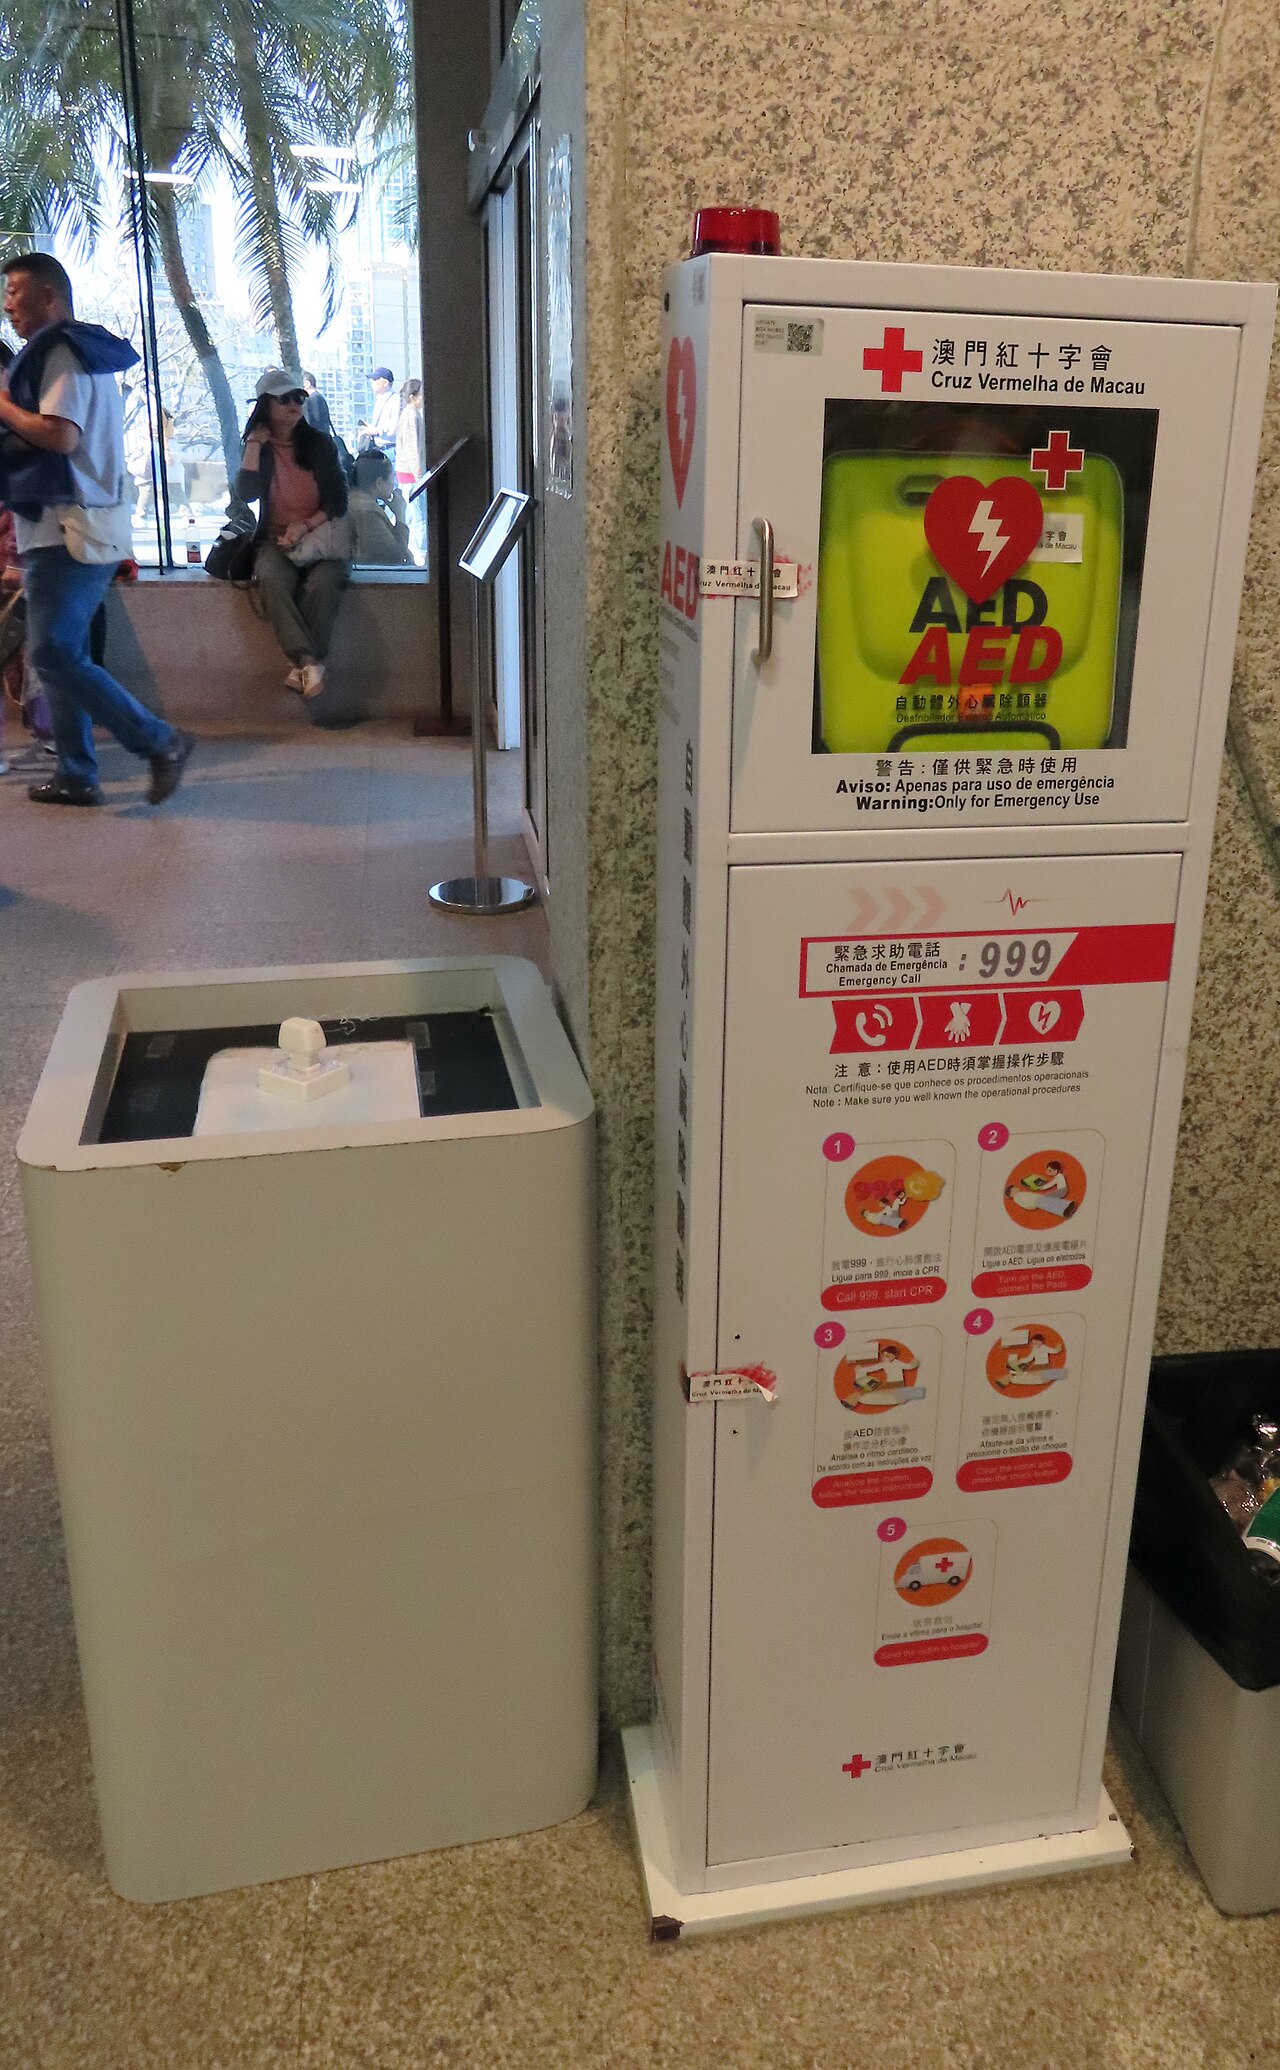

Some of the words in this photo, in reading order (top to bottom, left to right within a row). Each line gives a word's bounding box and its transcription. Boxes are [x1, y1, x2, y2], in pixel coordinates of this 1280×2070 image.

[931, 338, 1112, 371] 澳門紅十字會
[931, 370, 972, 388] Cruz
[978, 372, 1058, 392] Vermelha
[1063, 376, 1084, 392] de
[1090, 376, 1145, 395] Macau
[660, 540, 700, 620] AED
[707, 564, 782, 579] 澳門紅十會
[909, 576, 1048, 635] AED
[898, 625, 1063, 685] AED
[835, 779, 891, 794] Aviso:
[895, 778, 947, 794] Apenas
[952, 779, 982, 794] para
[986, 779, 1012, 790] uso
[1015, 777, 1032, 790] de
[1036, 775, 1115, 793] emergência
[971, 795, 990, 808] for
[994, 793, 1070, 810] Emergency
[1074, 792, 1100, 806] Use
[834, 942, 941, 962] 緊急求助電話
[978, 939, 1052, 979] 999
[826, 962, 873, 974] Chamada
[875, 961, 888, 972] de
[890, 959, 948, 973] Emergência
[838, 975, 898, 989] Emergency
[901, 973, 921, 985] Call
[894, 1080, 911, 1091] que
[913, 1077, 952, 1089] conhece
[954, 1078, 965, 1087] os
[966, 1073, 1032, 1087] procedimentos
[844, 1095, 869, 1107] Make
[872, 1096, 892, 1105] sure
[894, 1095, 911, 1106] you
[913, 1090, 931, 1102] well
[933, 1089, 962, 1101] known
[964, 1089, 979, 1099] the
[981, 1086, 1030, 1099] operational
[1032, 1083, 1081, 1095] procedures
[988, 1130, 998, 1144] 2
[834, 1140, 841, 1154] 1
[922, 1265, 940, 1275] CPR
[836, 1291, 857, 1303] Call
[884, 1288, 907, 1299] start
[910, 1285, 933, 1297] CPR
[972, 1315, 981, 1328] 4
[824, 1328, 833, 1342] 3
[887, 1524, 896, 1536] 5
